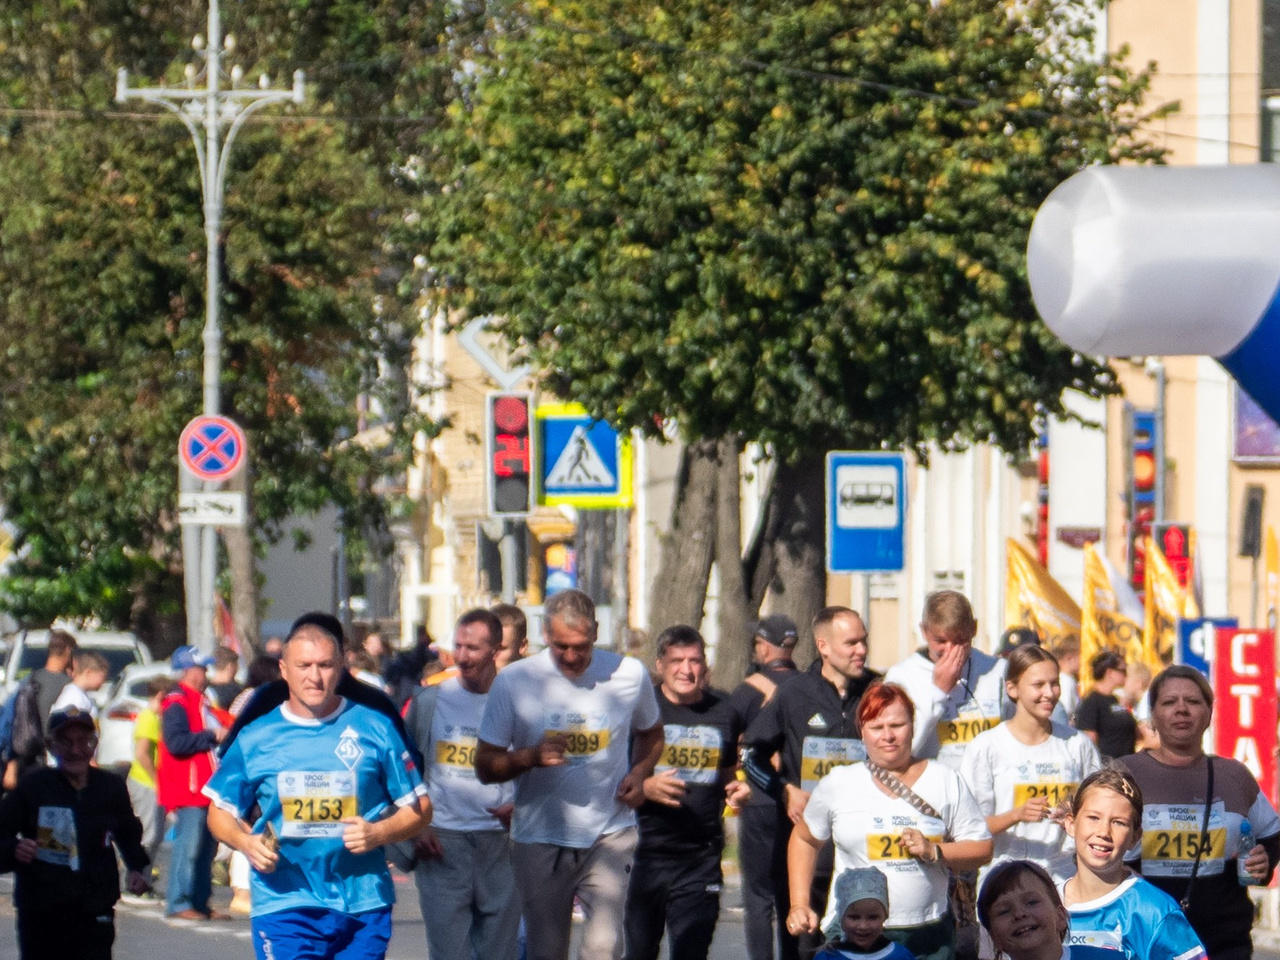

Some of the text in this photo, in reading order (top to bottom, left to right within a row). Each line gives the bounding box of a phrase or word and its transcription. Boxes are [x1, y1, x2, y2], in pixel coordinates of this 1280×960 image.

[556, 733, 600, 754] 399
[293, 798, 343, 821] 2153
[1156, 831, 1213, 858] 2154
